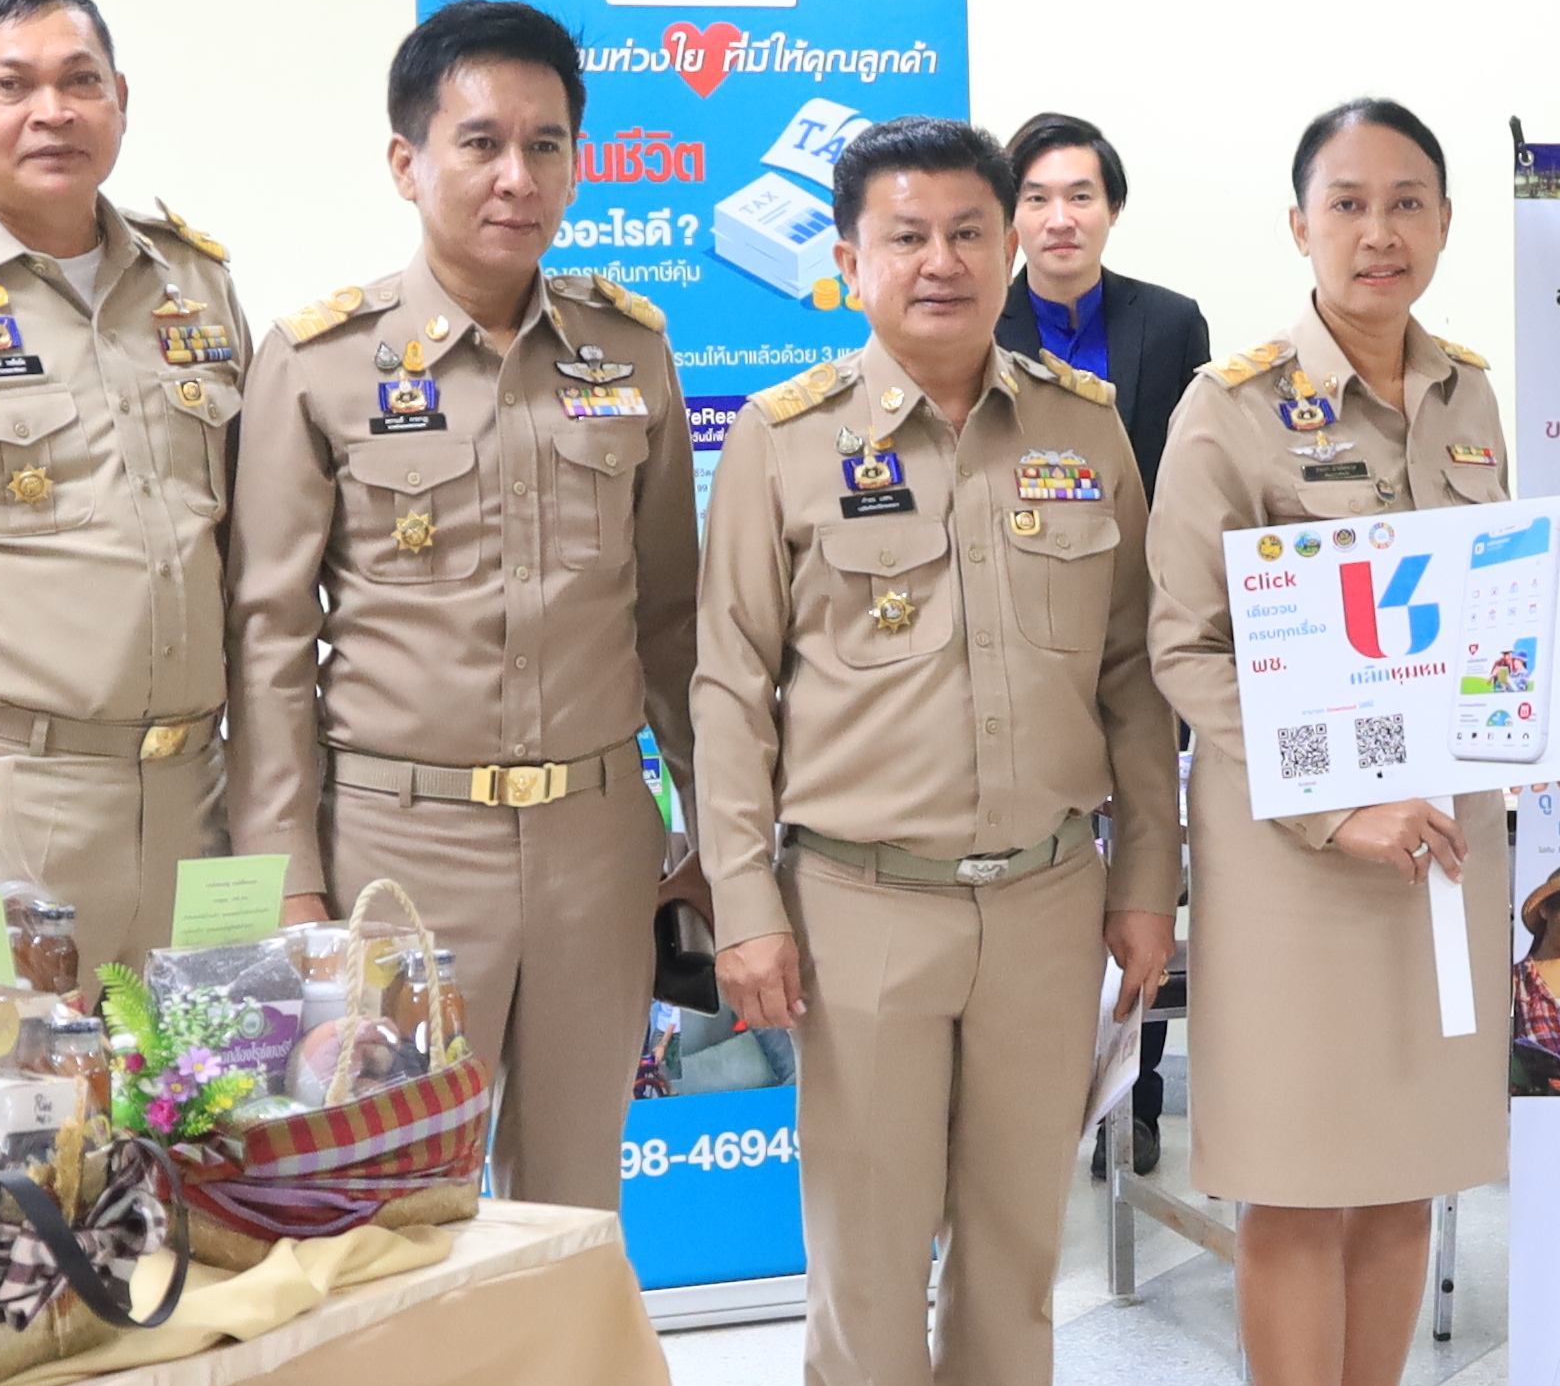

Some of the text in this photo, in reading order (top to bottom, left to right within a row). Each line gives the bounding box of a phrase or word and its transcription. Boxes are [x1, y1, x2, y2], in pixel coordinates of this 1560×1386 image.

[722, 33, 937, 83] ที่มีให้คุณลูกค้า
[738, 190, 778, 216] TAX
[679, 214, 698, 246] ?
[1244, 571, 1297, 592] Click
[1246, 598, 1297, 619] เดียวจบ
[1248, 619, 1327, 642] ครบทุกเรื่อง
